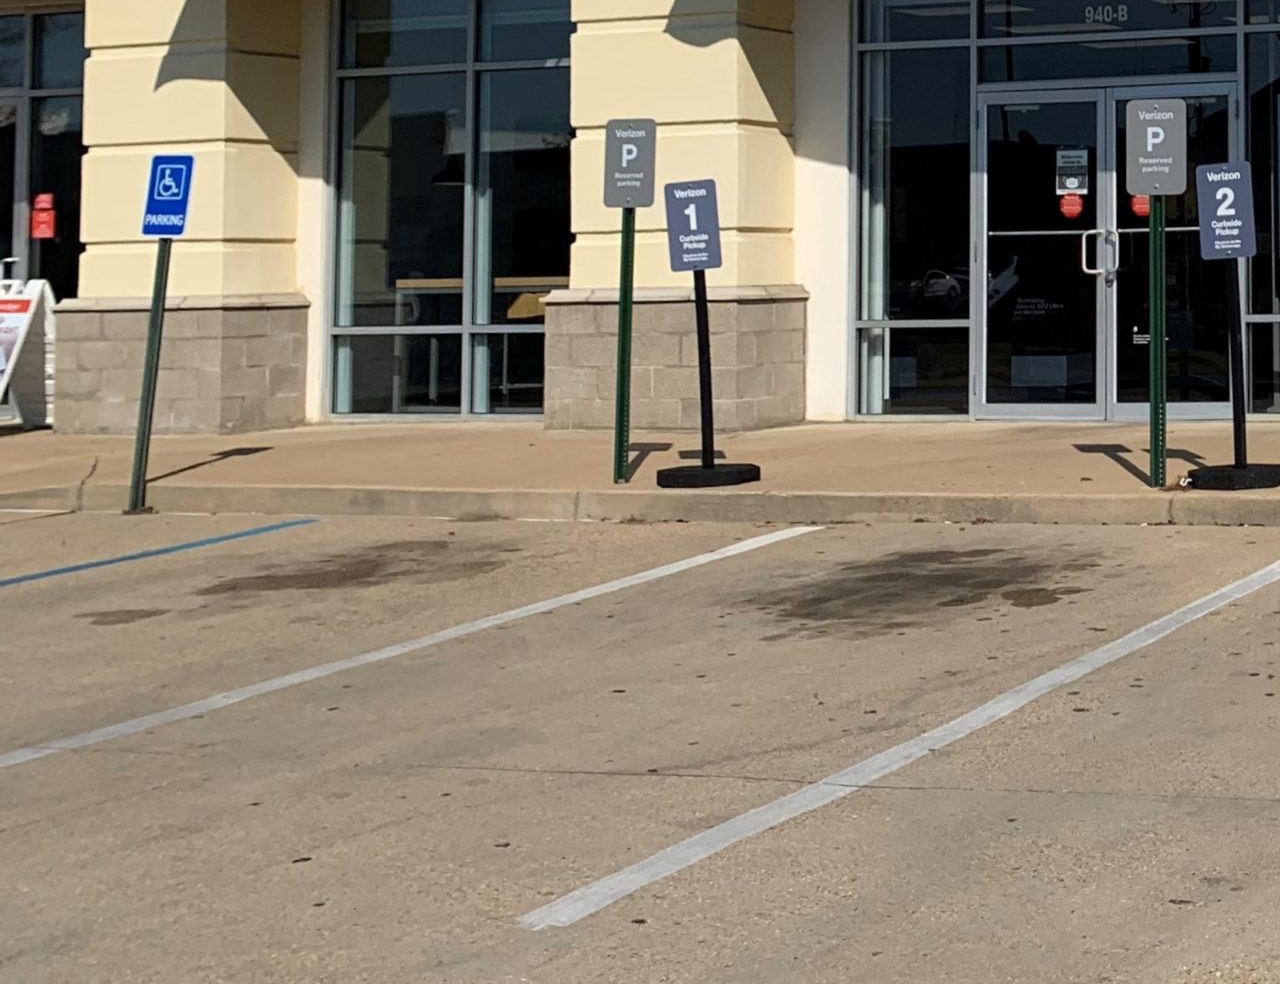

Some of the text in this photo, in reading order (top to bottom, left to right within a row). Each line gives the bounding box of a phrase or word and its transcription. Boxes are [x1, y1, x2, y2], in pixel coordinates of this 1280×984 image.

[1085, 4, 1128, 24] 940-B
[1138, 111, 1174, 120] Verizon
[615, 129, 646, 138] Verizon
[1147, 127, 1165, 152] P
[622, 144, 638, 167] P
[1142, 165, 1169, 173] parking
[1206, 171, 1241, 182] Verizon
[673, 188, 707, 199] Verizon
[1215, 187, 1236, 217] 2
[144, 214, 184, 226] PARKING
[684, 203, 697, 230] 1
[1211, 219, 1243, 228] Curbside
[1215, 228, 1239, 236] Pickup
